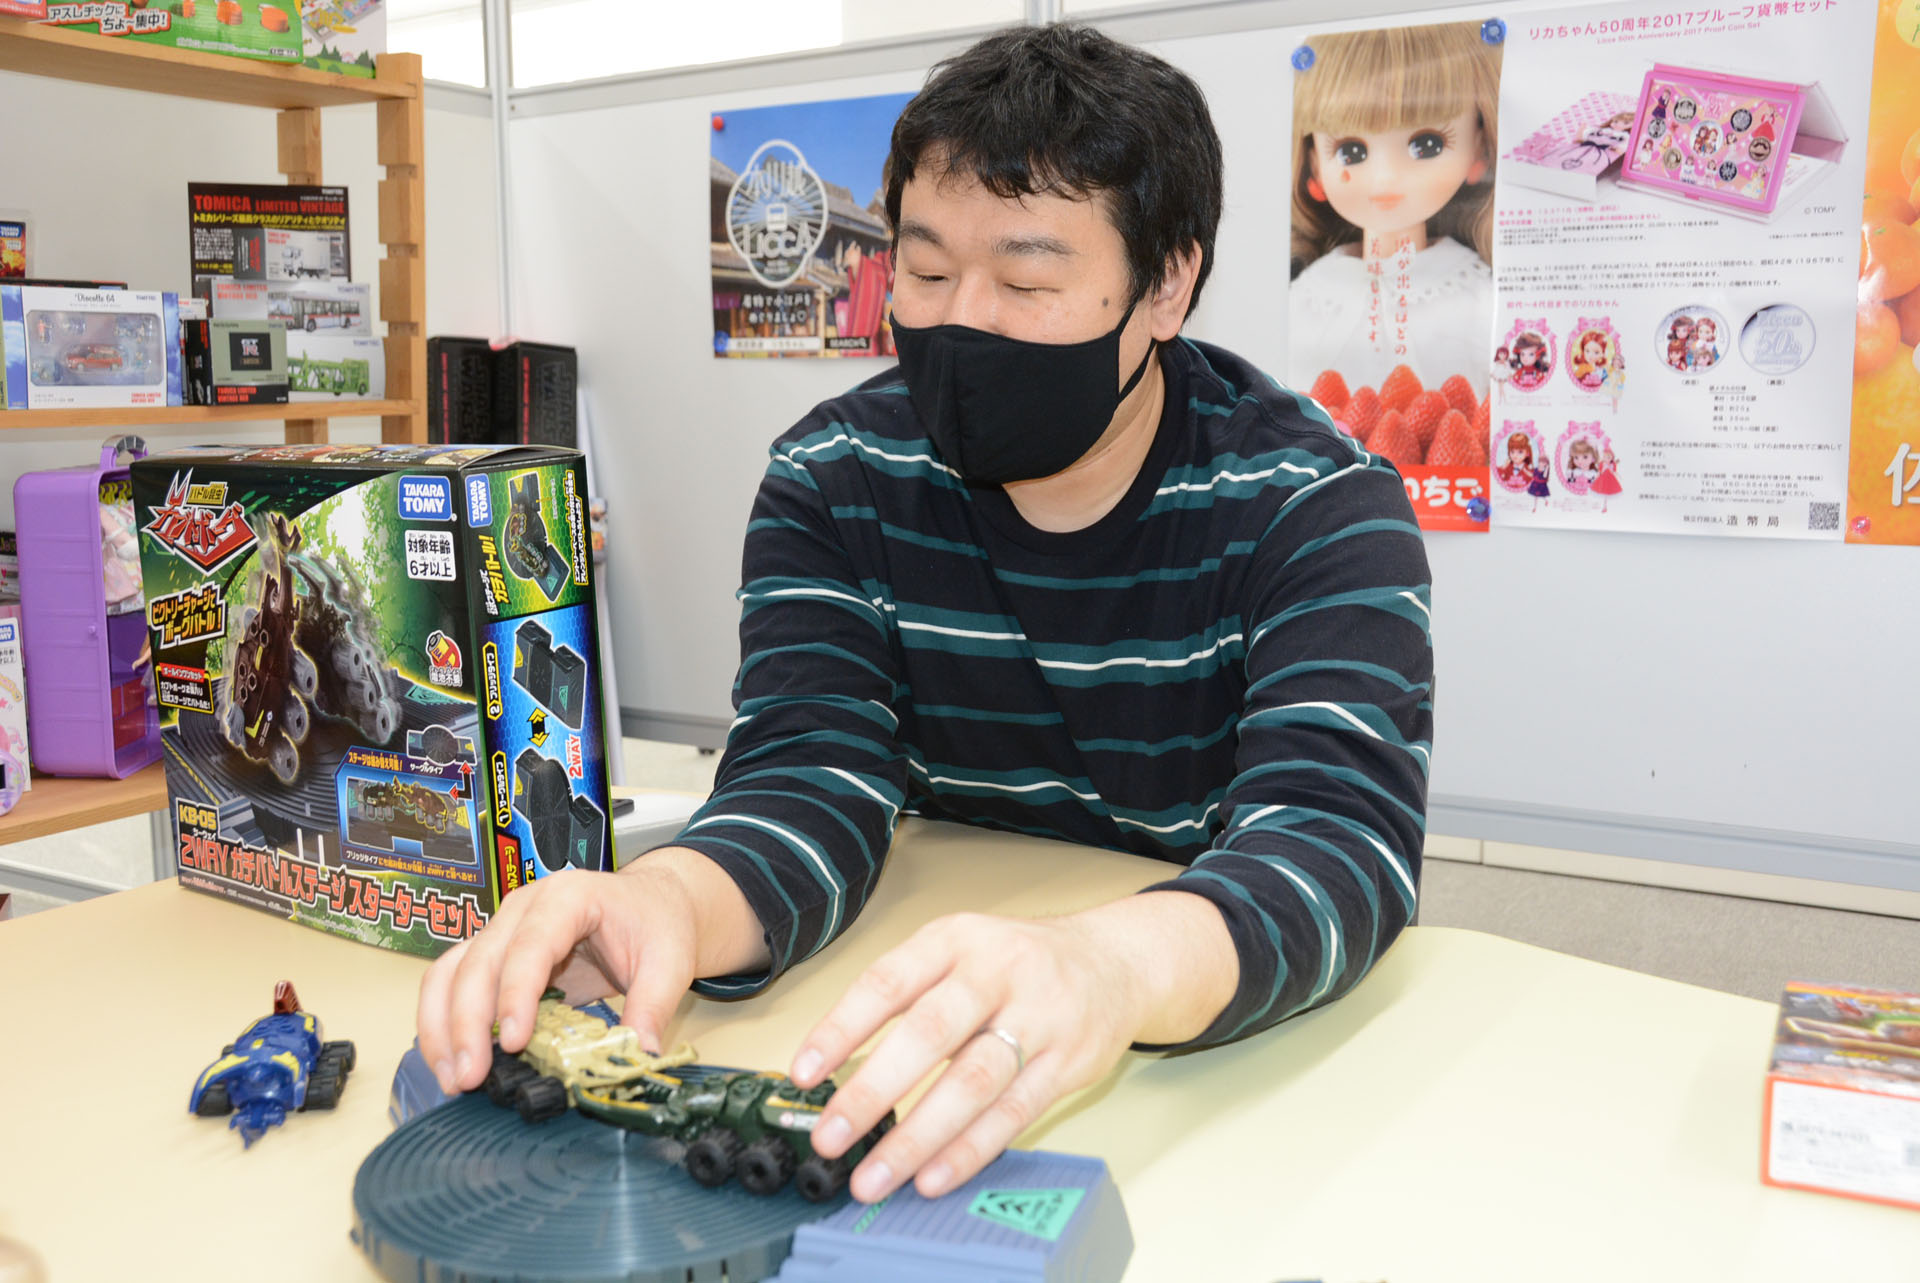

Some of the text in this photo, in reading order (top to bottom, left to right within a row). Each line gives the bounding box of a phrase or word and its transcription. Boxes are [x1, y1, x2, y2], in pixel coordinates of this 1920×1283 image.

[194, 194, 345, 214] TOMICA LIMITED VINTAGE
[1813, 206, 1836, 214] TOMY
[403, 482, 445, 499] TAKARA
[403, 496, 446, 514] TOMY
[469, 479, 481, 523] TAKARA
[477, 479, 489, 522] TOMY
[407, 538, 452, 555] 対象年齢
[409, 561, 453, 578] 6才以上
[569, 735, 583, 778] 2WAY
[180, 833, 229, 877] 2WAY
[231, 846, 346, 911] ガチバトルステージ
[349, 877, 484, 938] スターターセット
